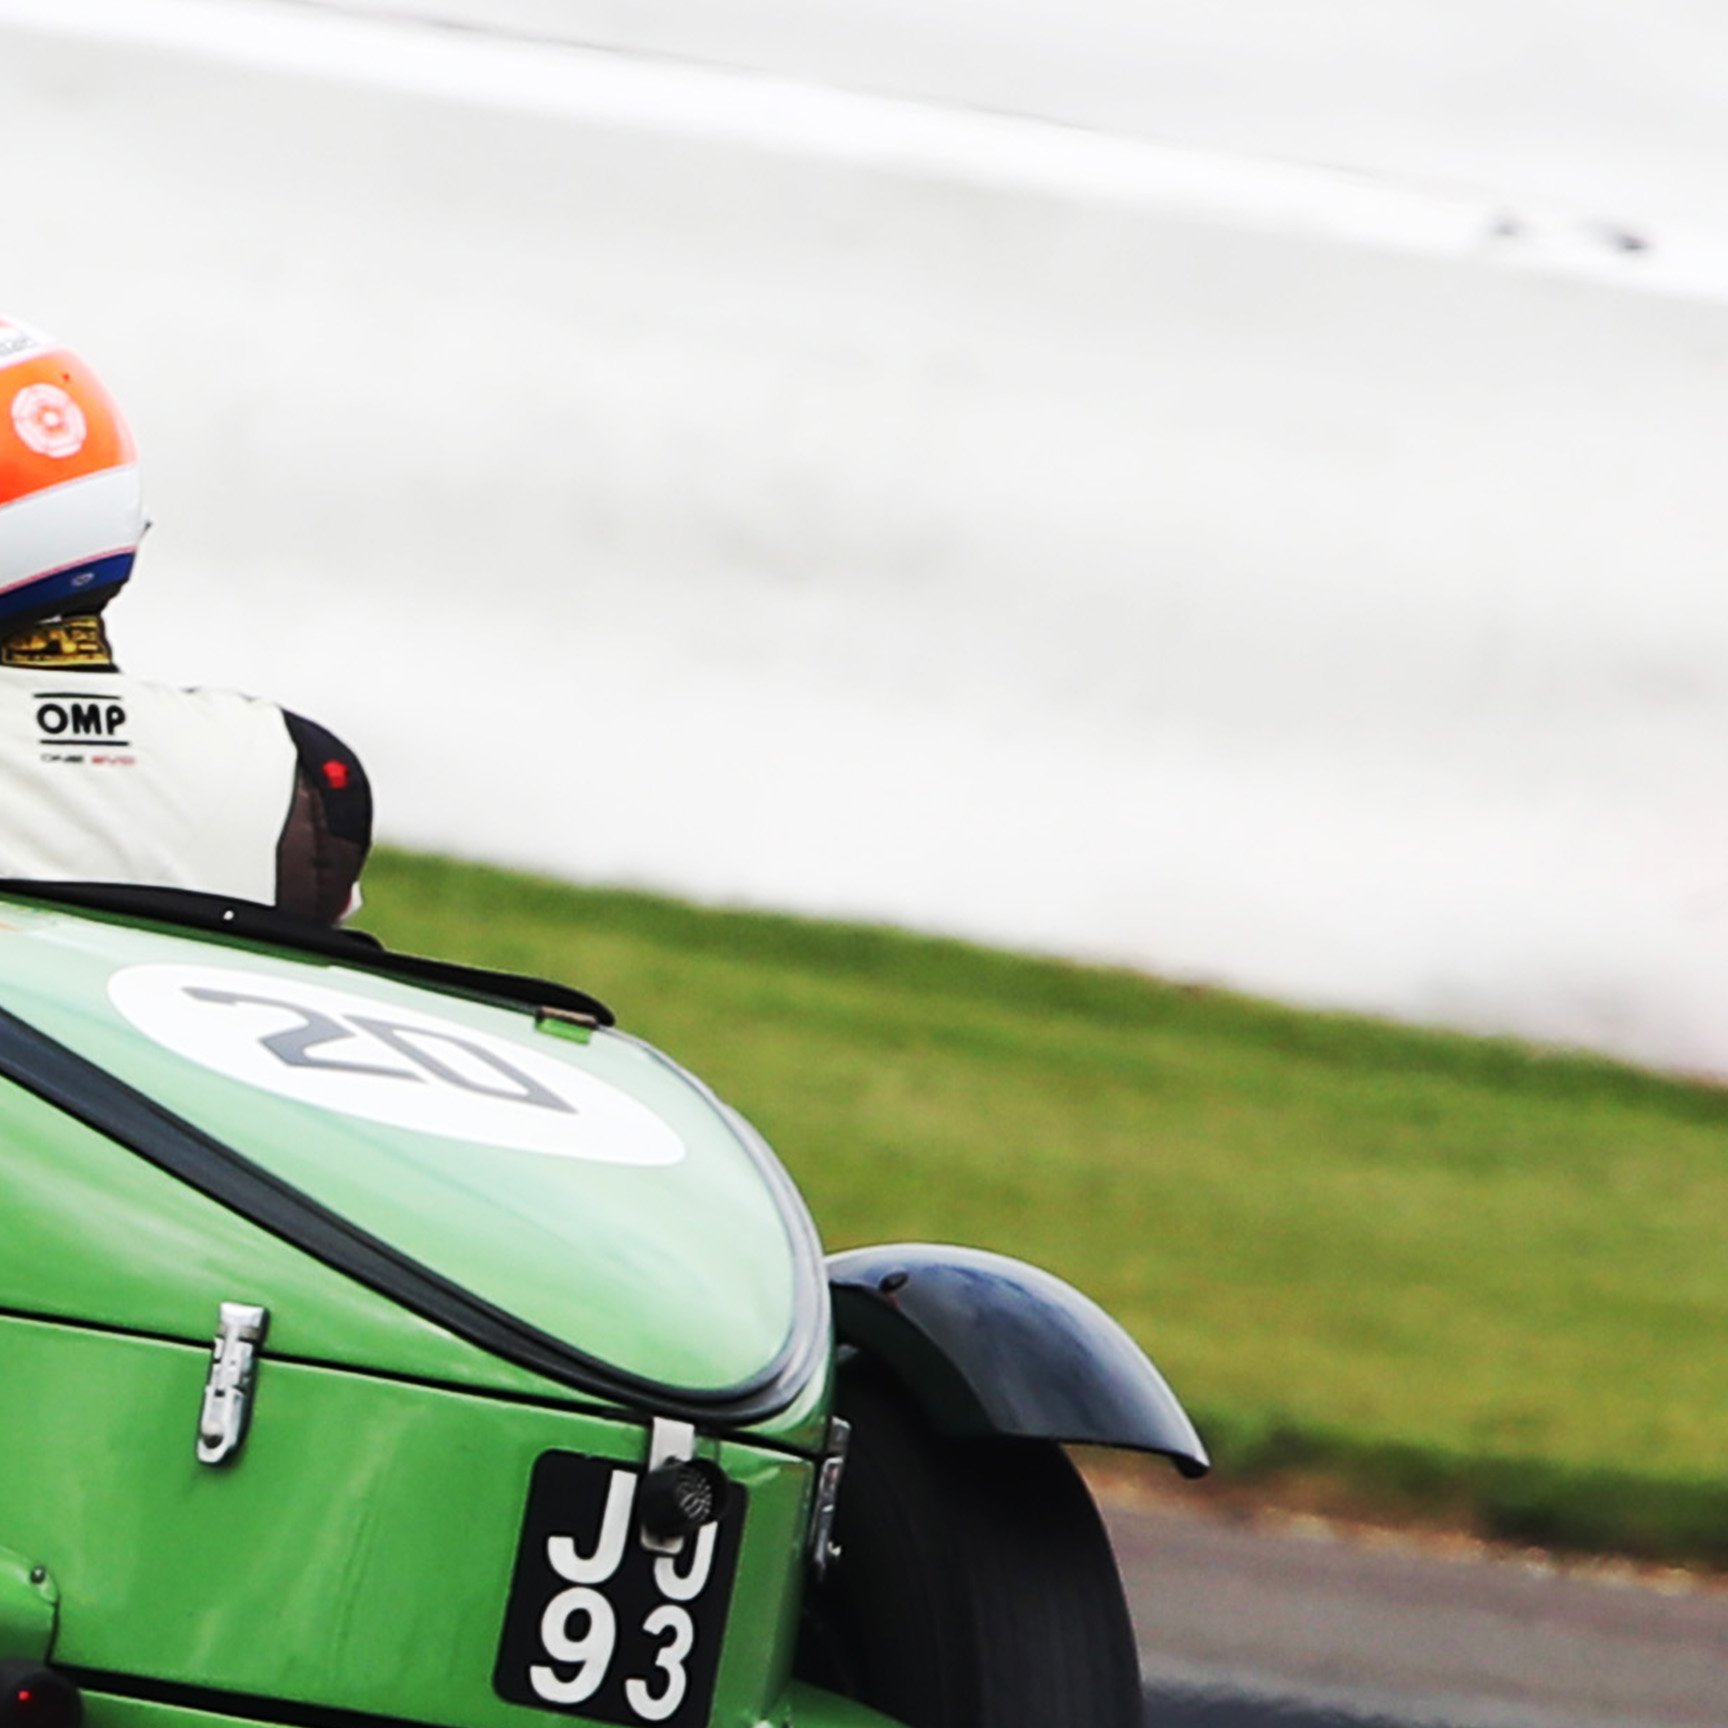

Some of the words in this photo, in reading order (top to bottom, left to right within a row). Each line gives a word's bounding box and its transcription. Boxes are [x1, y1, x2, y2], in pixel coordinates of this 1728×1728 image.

[36, 703, 126, 736] OMP
[183, 985, 580, 1115] 20
[529, 1586, 695, 1721] 93
